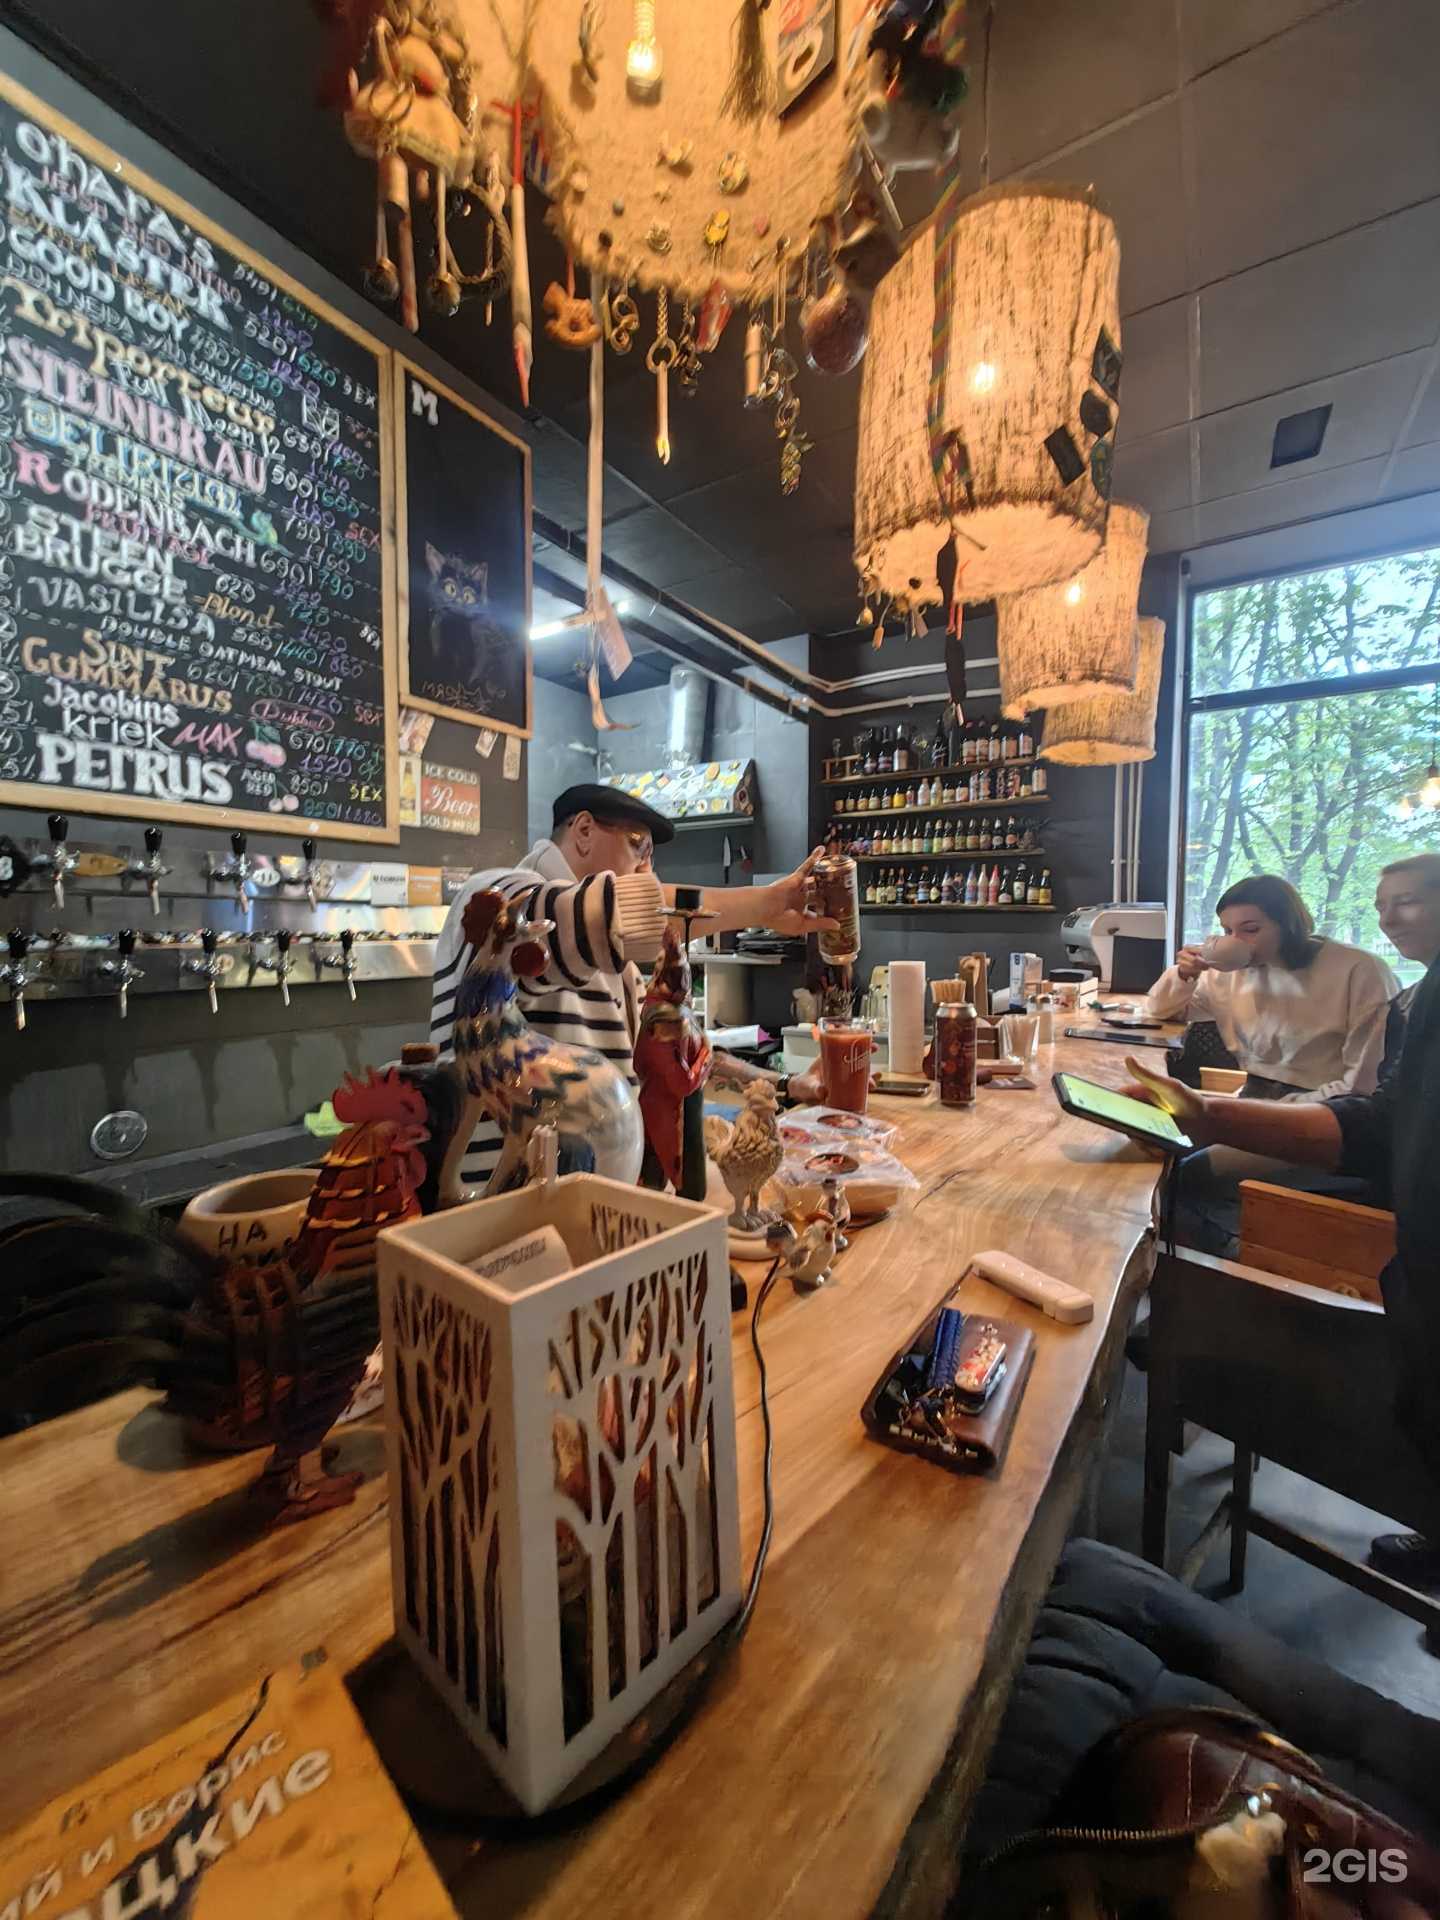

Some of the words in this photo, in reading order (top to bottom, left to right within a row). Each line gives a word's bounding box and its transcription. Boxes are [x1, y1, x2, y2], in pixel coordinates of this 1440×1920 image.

[7, 218, 115, 306] GOOD
[124, 284, 188, 347] BOY
[22, 632, 231, 714] GUMMARUS
[42, 675, 181, 730] Jacobins
[293, 665, 343, 692] STOUT
[36, 732, 233, 804] PETRUS
[424, 764, 445, 778] ICE
[447, 768, 479, 785] COLD
[424, 783, 479, 816] Beer
[422, 814, 450, 828] SOLD
[57, 1748, 332, 1920] цкие
[81, 1835, 115, 1878] и
[131, 1730, 288, 1841] Борис
